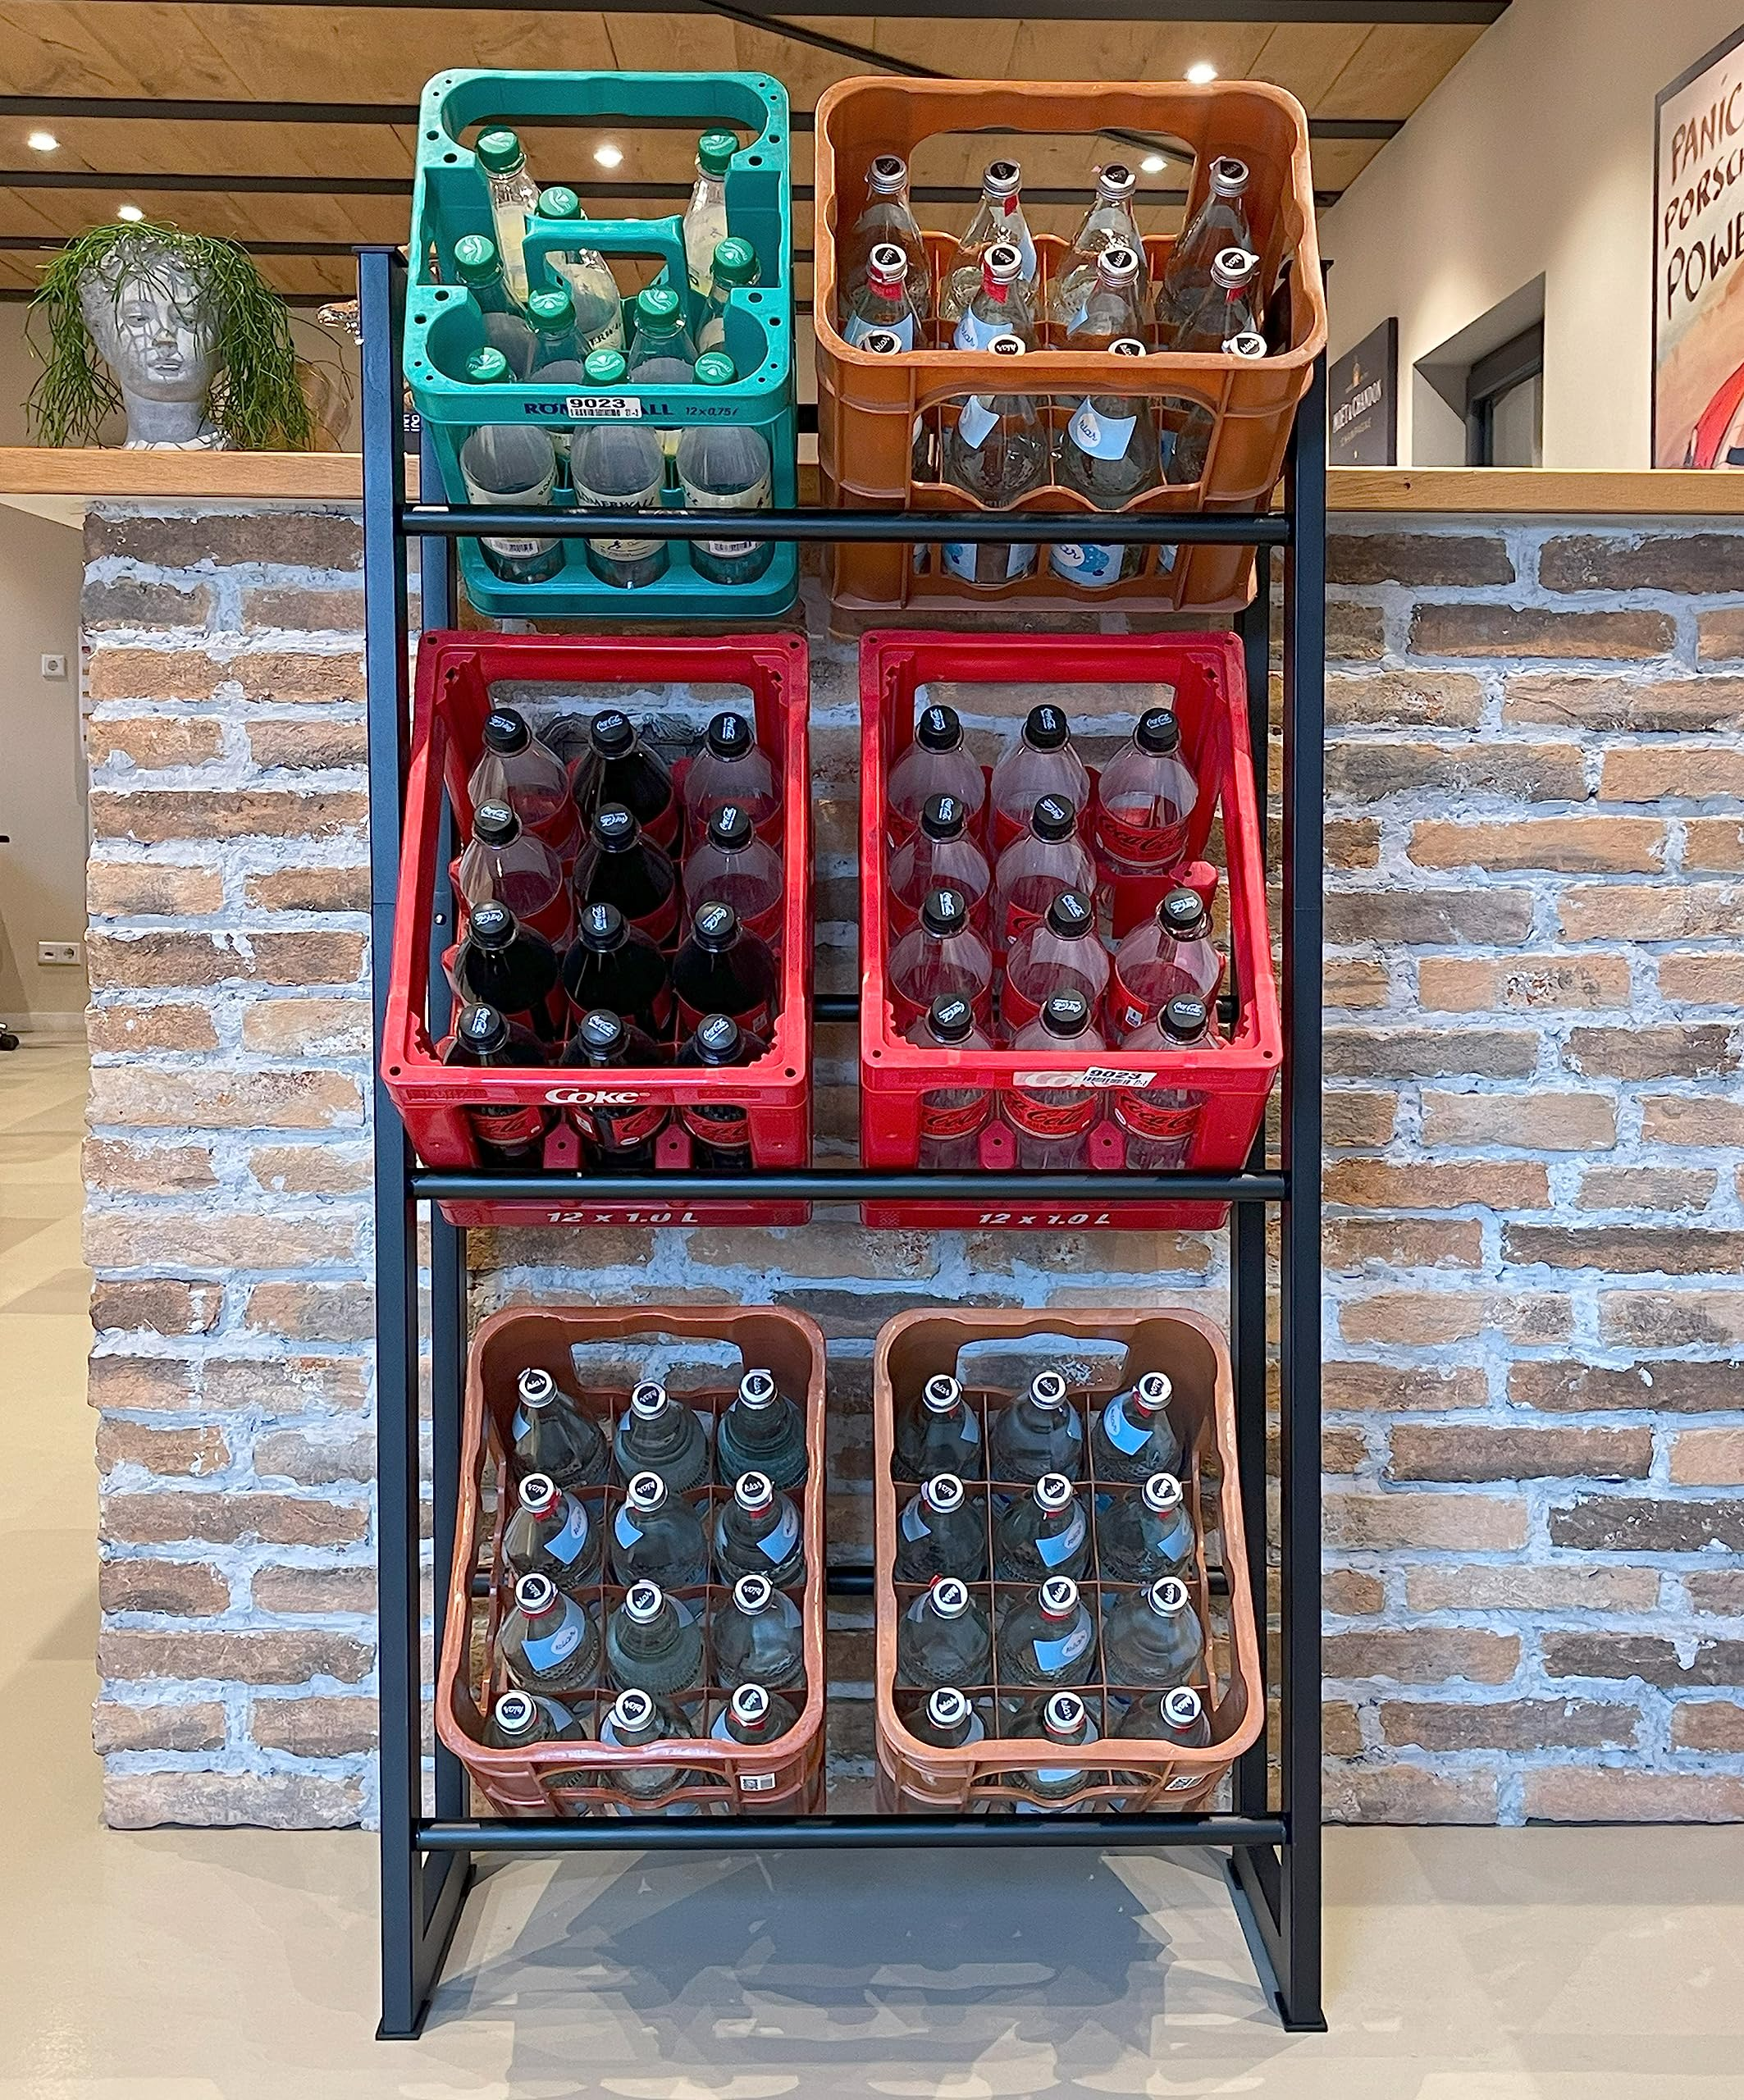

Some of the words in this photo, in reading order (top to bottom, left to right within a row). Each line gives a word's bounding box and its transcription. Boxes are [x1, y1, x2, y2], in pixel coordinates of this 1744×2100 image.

[570, 399, 626, 408] 9023
[545, 1088, 639, 1104] Coke
[547, 1212, 584, 1222] 12
[595, 1213, 614, 1222] x
[681, 1212, 698, 1222] L
[979, 1213, 1011, 1224] 12
[1017, 1214, 1038, 1225] x
[1047, 1213, 1089, 1225] 1.0
[1094, 1213, 1111, 1225] L
